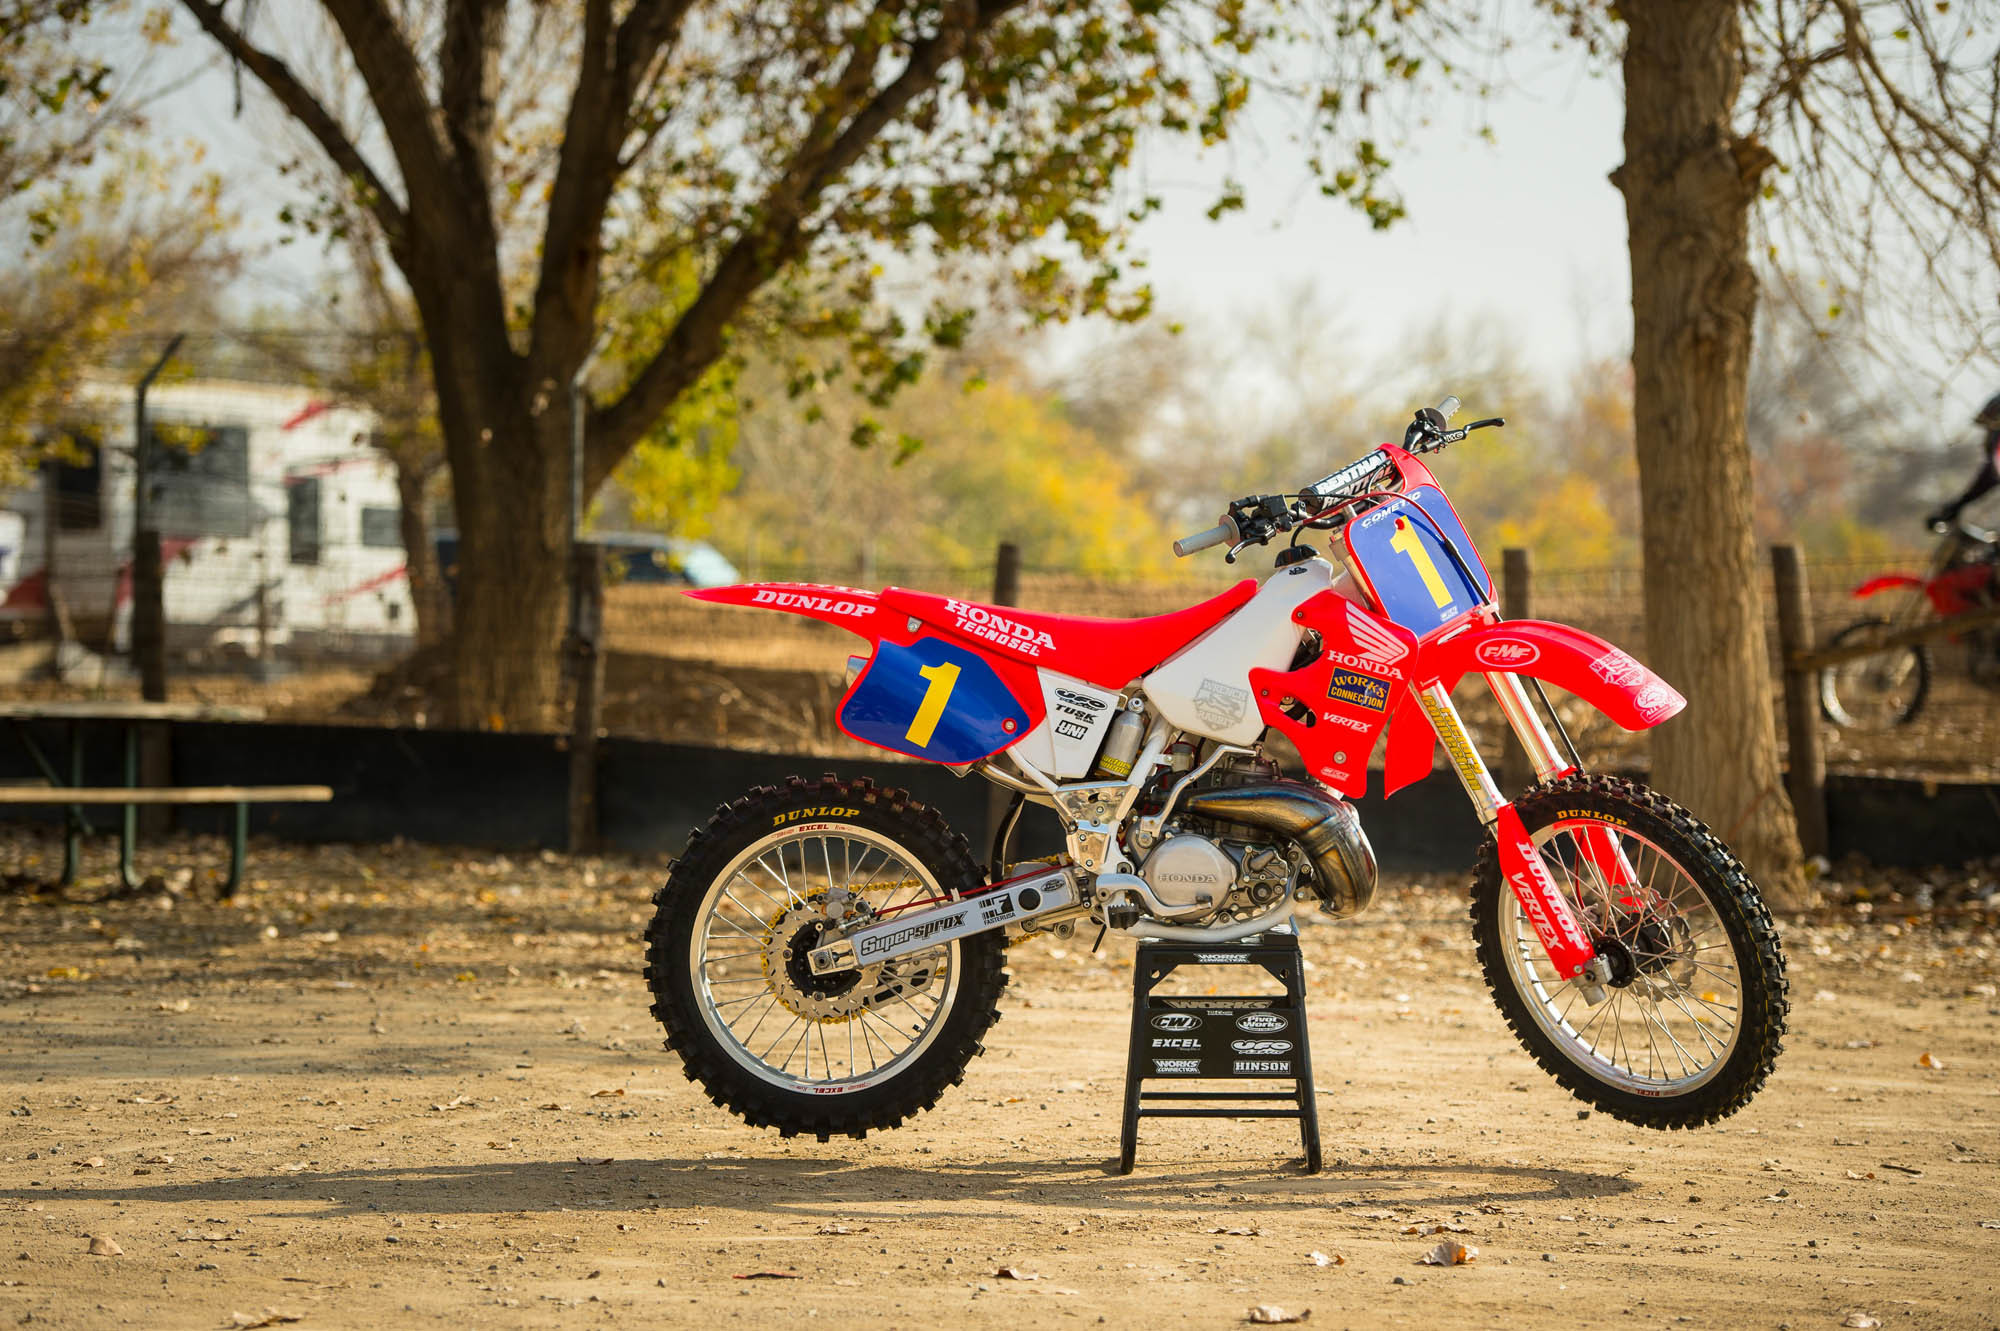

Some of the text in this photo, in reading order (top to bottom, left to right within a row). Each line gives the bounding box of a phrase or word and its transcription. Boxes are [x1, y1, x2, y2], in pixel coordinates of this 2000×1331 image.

[1361, 491, 1421, 528] COMETC
[1390, 515, 1454, 609] 1
[752, 590, 876, 617] DUNLOP
[944, 598, 1057, 651] HONDA
[955, 617, 1040, 657] TECNOSEL
[1483, 644, 1532, 658] FMF
[1327, 650, 1404, 680] HONDA
[1334, 675, 1387, 698] WORKS
[905, 661, 962, 749] 1
[1056, 689, 1107, 709] UFO
[1331, 686, 1384, 709] CONNECTION
[1055, 704, 1099, 721] TUSK
[1323, 712, 1373, 733] VERTEX
[1057, 721, 1087, 739] UNI
[773, 807, 860, 827] DUNLOP
[1556, 809, 1628, 826] DUNLOP
[799, 824, 829, 832] EXCEL
[1158, 873, 1217, 883] HONDA
[1516, 842, 1586, 951] DUNLOP
[1511, 872, 1566, 951] VERTEX
[861, 911, 968, 956] Supersprox
[1173, 1000, 1272, 1009] WORKS
[1152, 1039, 1201, 1047] EXCEL
[1232, 1041, 1292, 1051] UFO
[1235, 1062, 1289, 1071] HINSON
